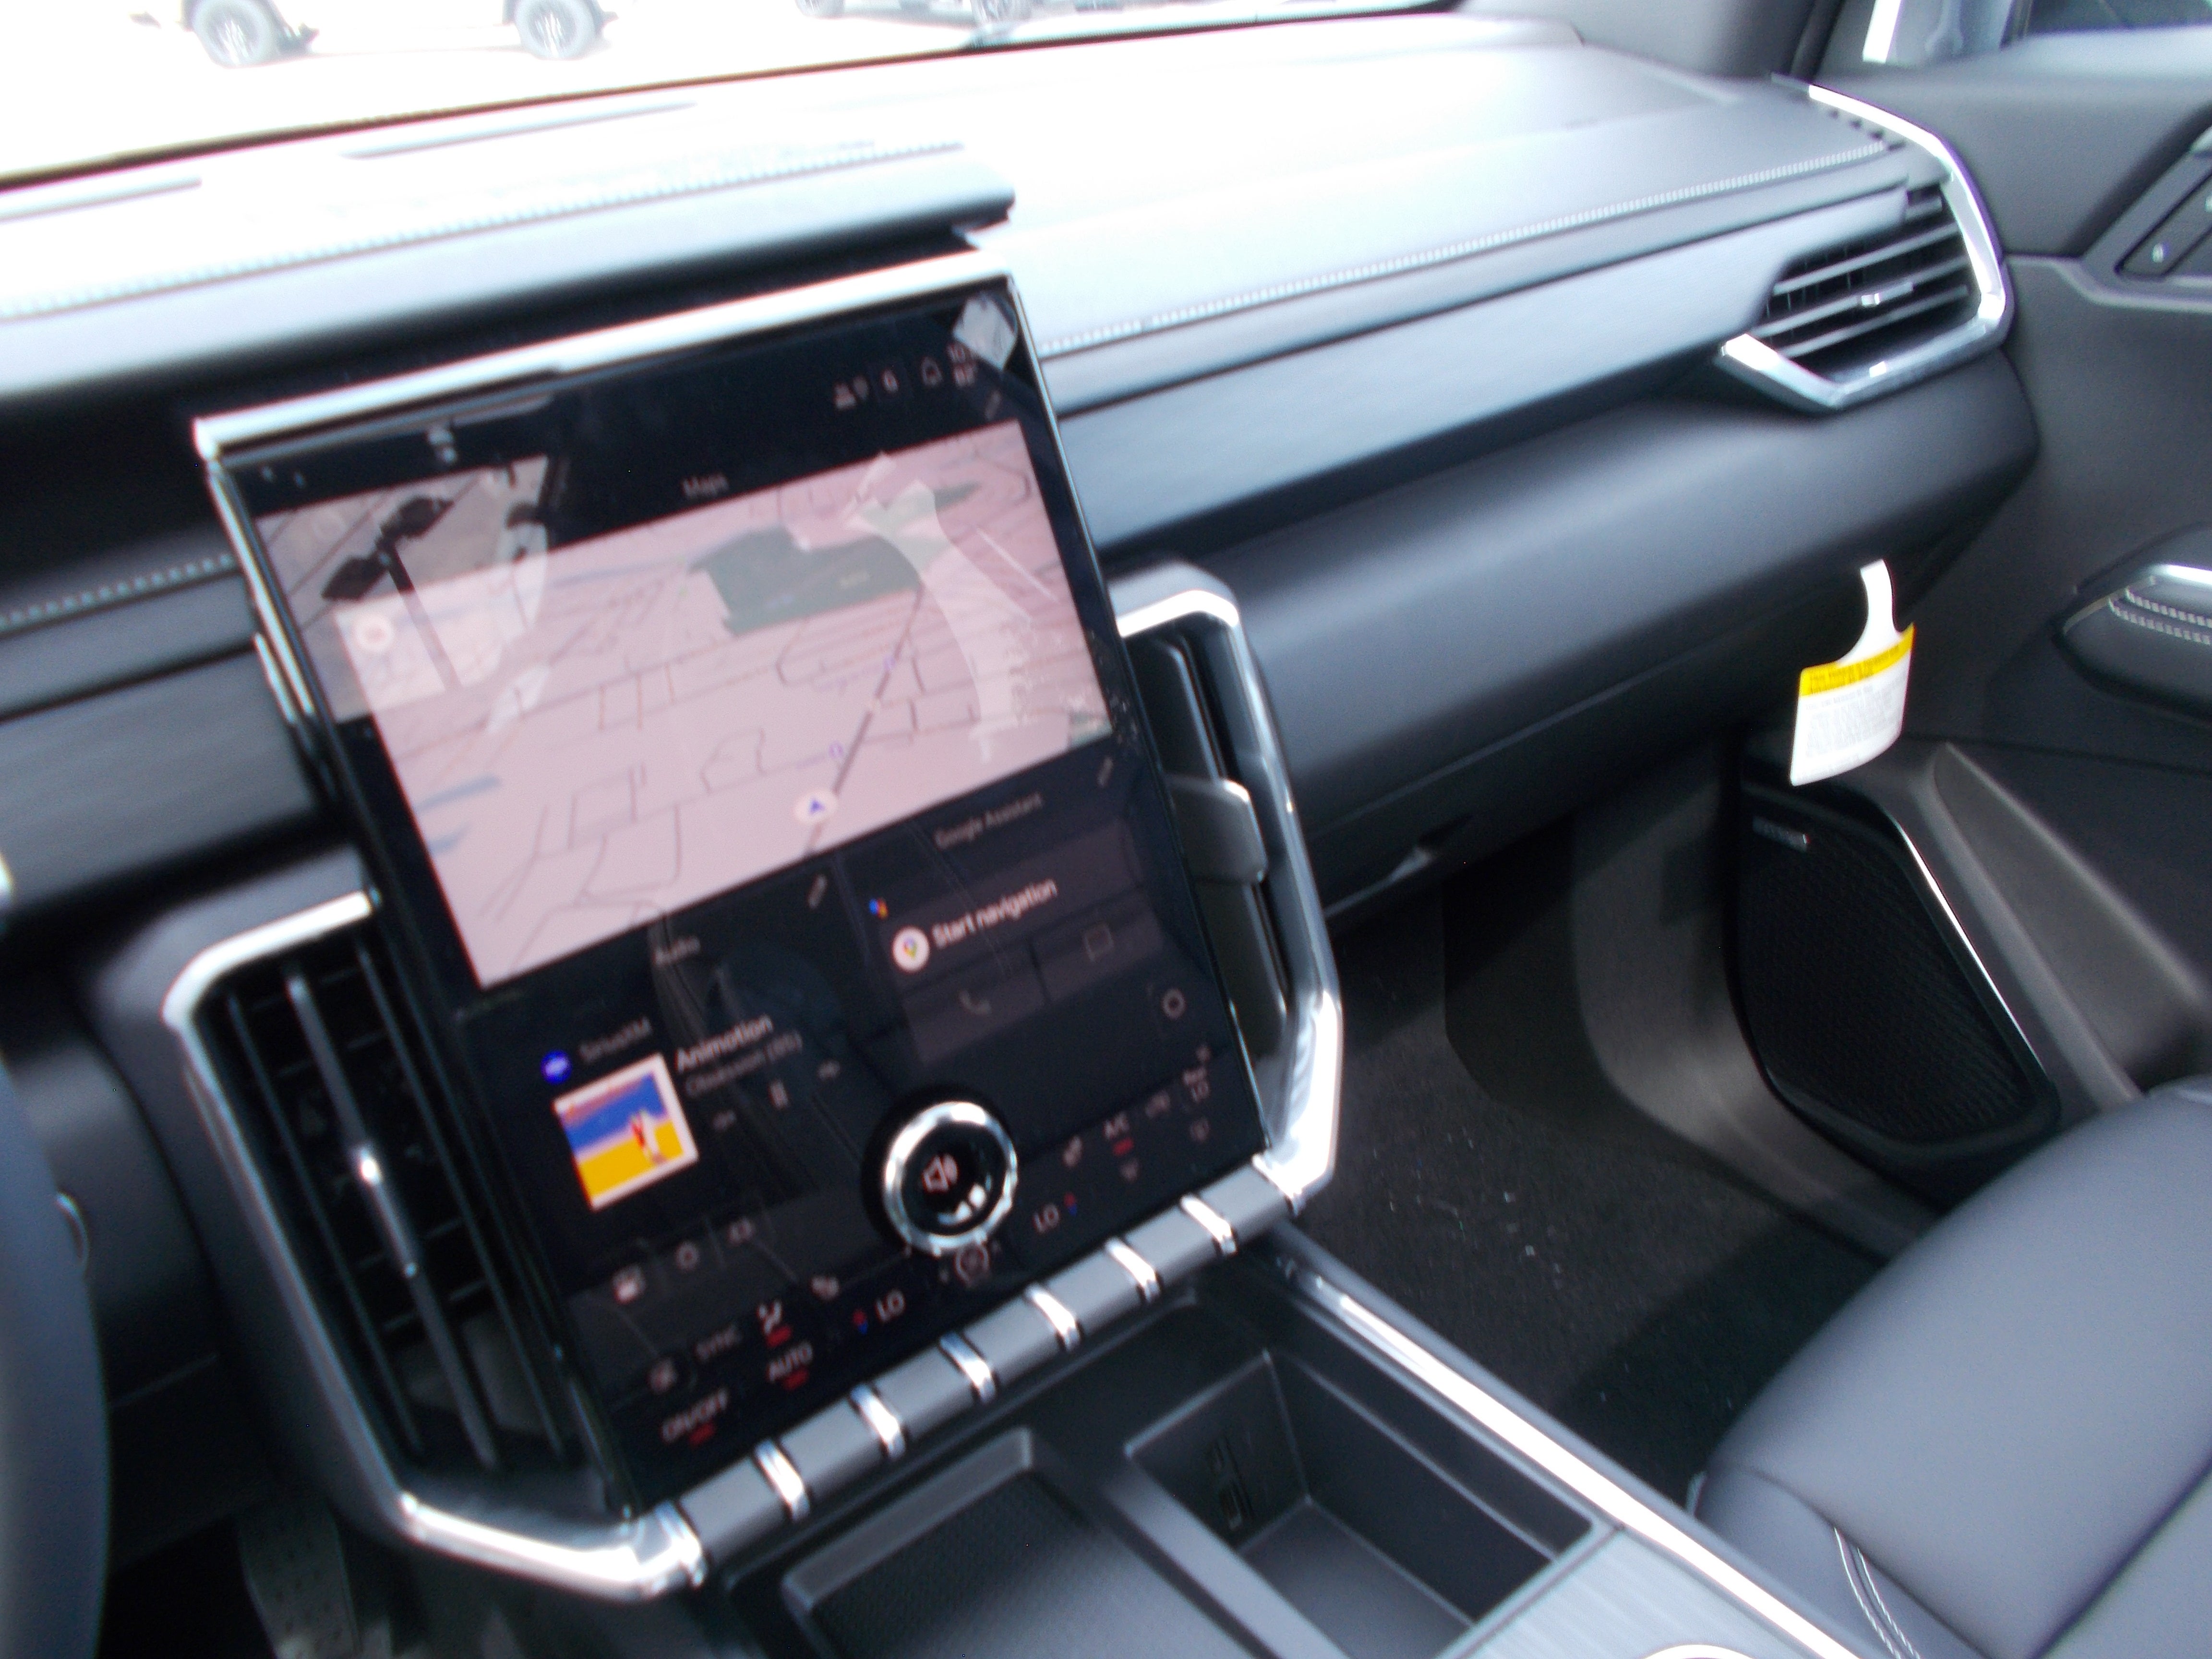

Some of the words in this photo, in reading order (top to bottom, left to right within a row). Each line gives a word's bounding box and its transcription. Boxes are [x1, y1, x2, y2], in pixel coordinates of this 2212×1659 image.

[934, 818, 983, 850] Google
[932, 913, 975, 949] Start
[976, 879, 1058, 929] navigation
[675, 1015, 774, 1074] Animotion
[1034, 1204, 1060, 1234] LO
[876, 1289, 906, 1323] LO
[768, 1342, 813, 1383] AUTO
